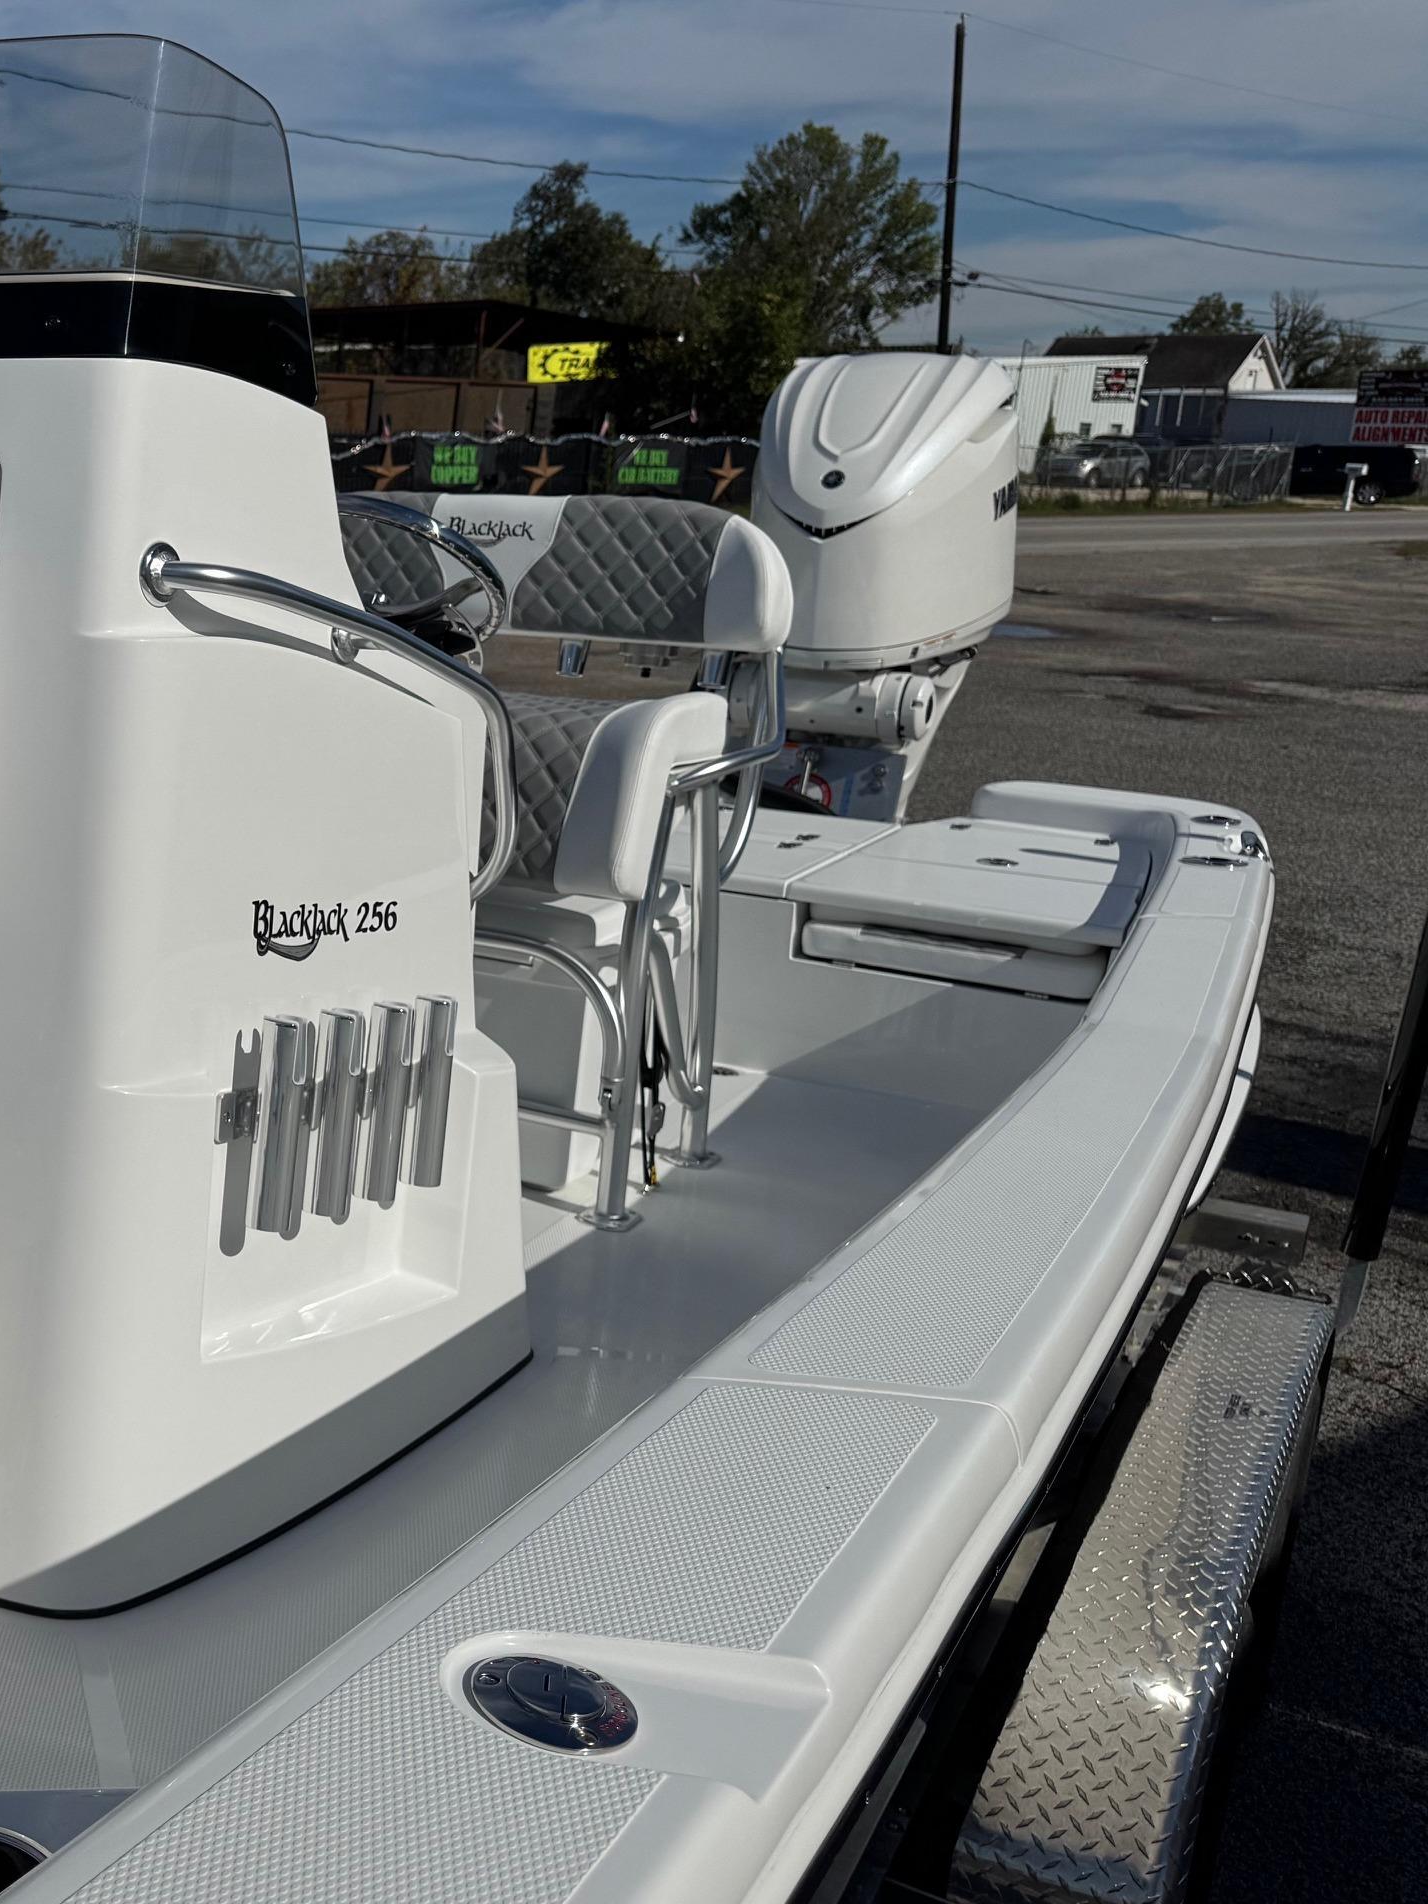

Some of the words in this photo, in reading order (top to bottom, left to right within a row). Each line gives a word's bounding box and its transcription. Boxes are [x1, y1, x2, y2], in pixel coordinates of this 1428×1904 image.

[1355, 409, 1388, 423] AUTO
[453, 445, 477, 464] BUY
[430, 465, 479, 484] COPPER
[355, 900, 398, 934] 256
